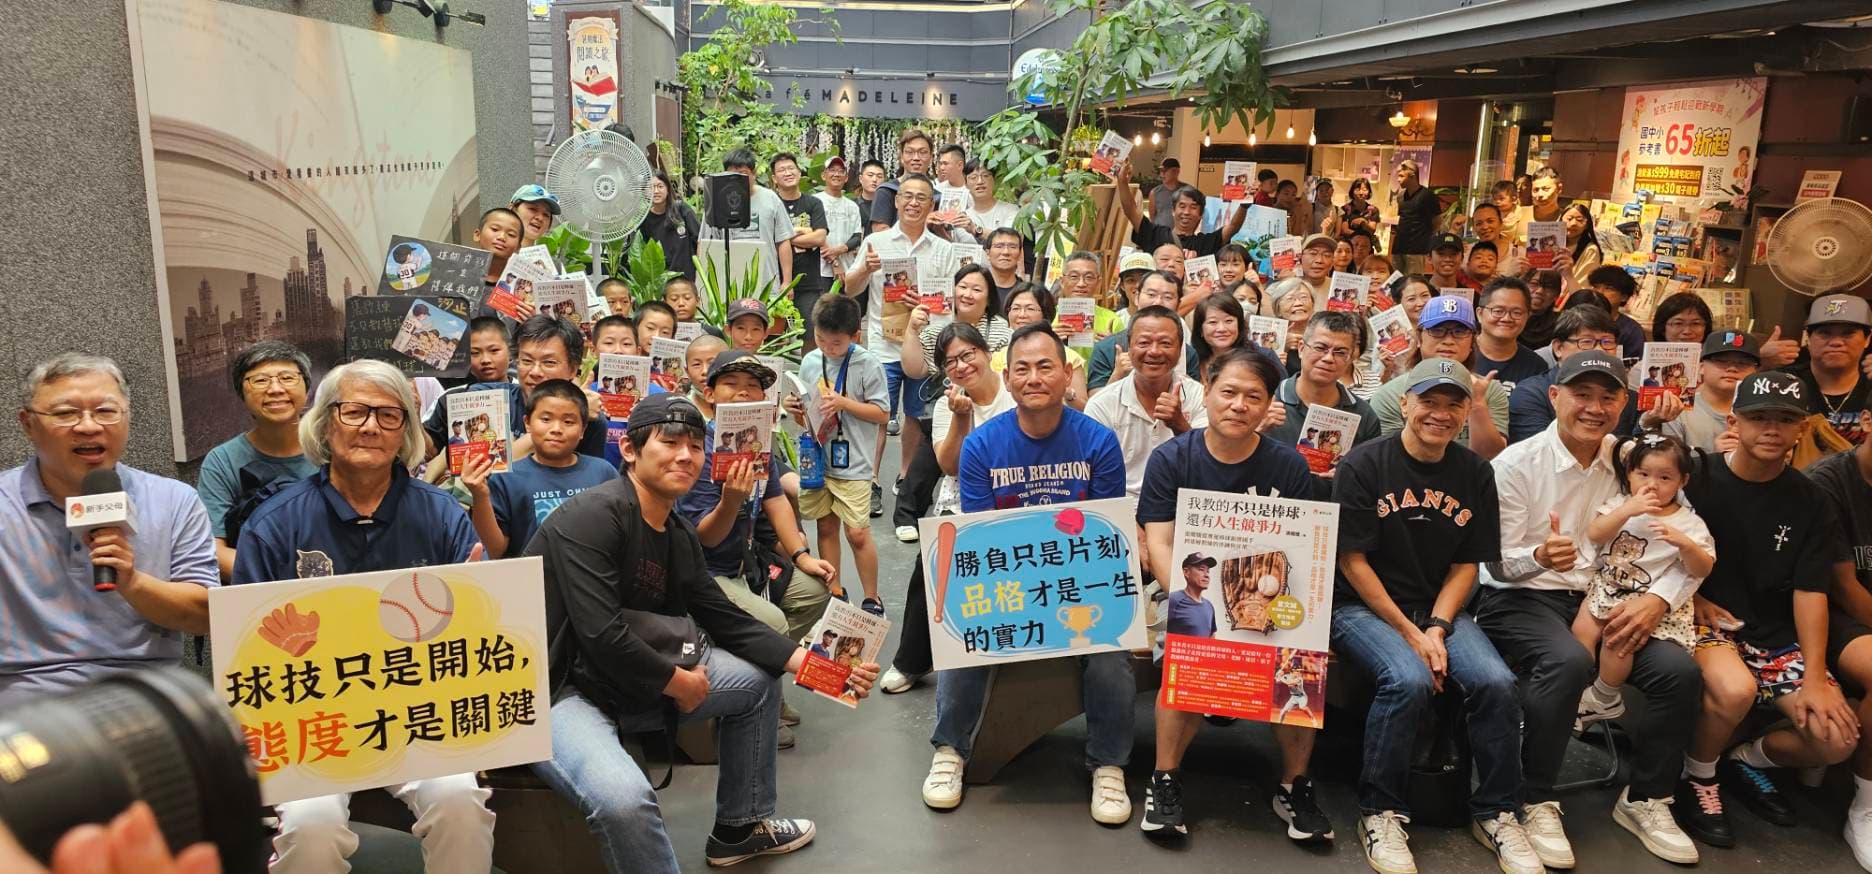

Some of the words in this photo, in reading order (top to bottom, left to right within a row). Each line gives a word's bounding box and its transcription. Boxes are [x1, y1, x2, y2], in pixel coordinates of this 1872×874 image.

[822, 89, 958, 106] MADELEINE
[1640, 126, 1664, 140] 國中小
[1665, 122, 1732, 158] 65折起
[1581, 360, 1612, 369] CELINE
[990, 467, 1026, 490] TRUE
[1028, 461, 1091, 482] RELIGION
[86, 502, 123, 513] 新手父母
[533, 490, 561, 499] JUST
[1187, 496, 1306, 520] 我教的不只是棒球，
[1377, 488, 1473, 527] GIANTS
[1186, 512, 1282, 535] 還有人生競爭力
[955, 533, 1130, 578] 勝負只是片刻，
[961, 571, 1139, 619] 品格才是一生
[963, 620, 1045, 653] 的實力
[225, 634, 529, 709] 球技只是開始，
[240, 687, 537, 774] 態度才是關鍵
